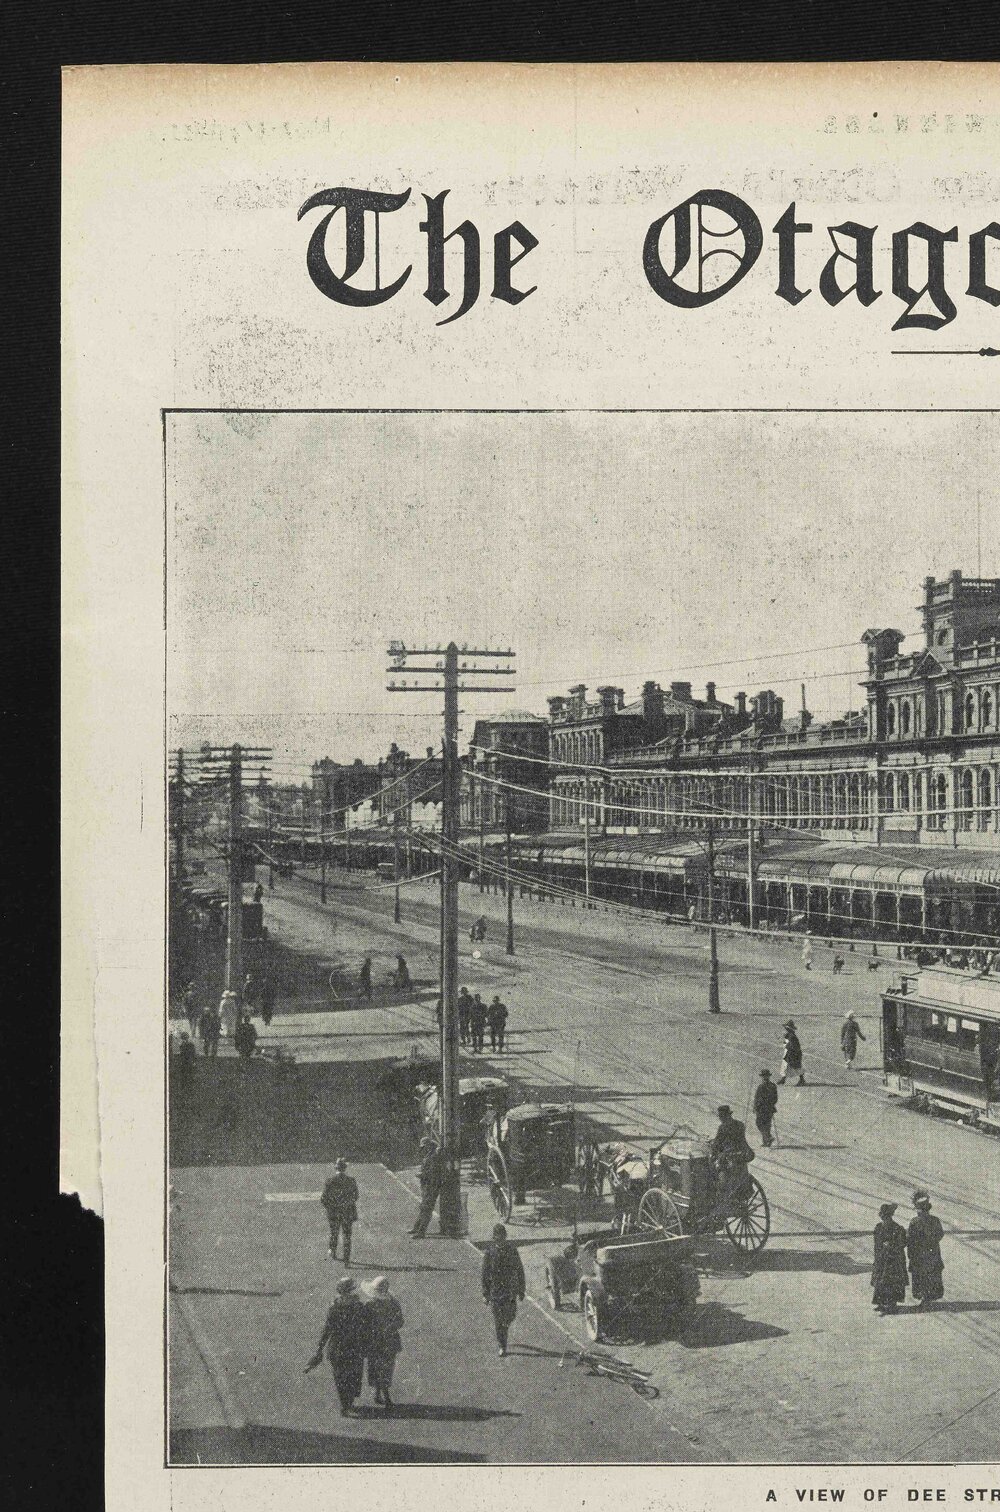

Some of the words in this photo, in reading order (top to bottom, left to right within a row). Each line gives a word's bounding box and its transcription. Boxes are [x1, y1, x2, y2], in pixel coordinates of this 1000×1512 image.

[297, 187, 539, 326] The
[766, 1490, 777, 1501] A
[796, 1489, 845, 1502] VIEW
[864, 1489, 887, 1501] OF
[908, 1489, 945, 1501] DEE
